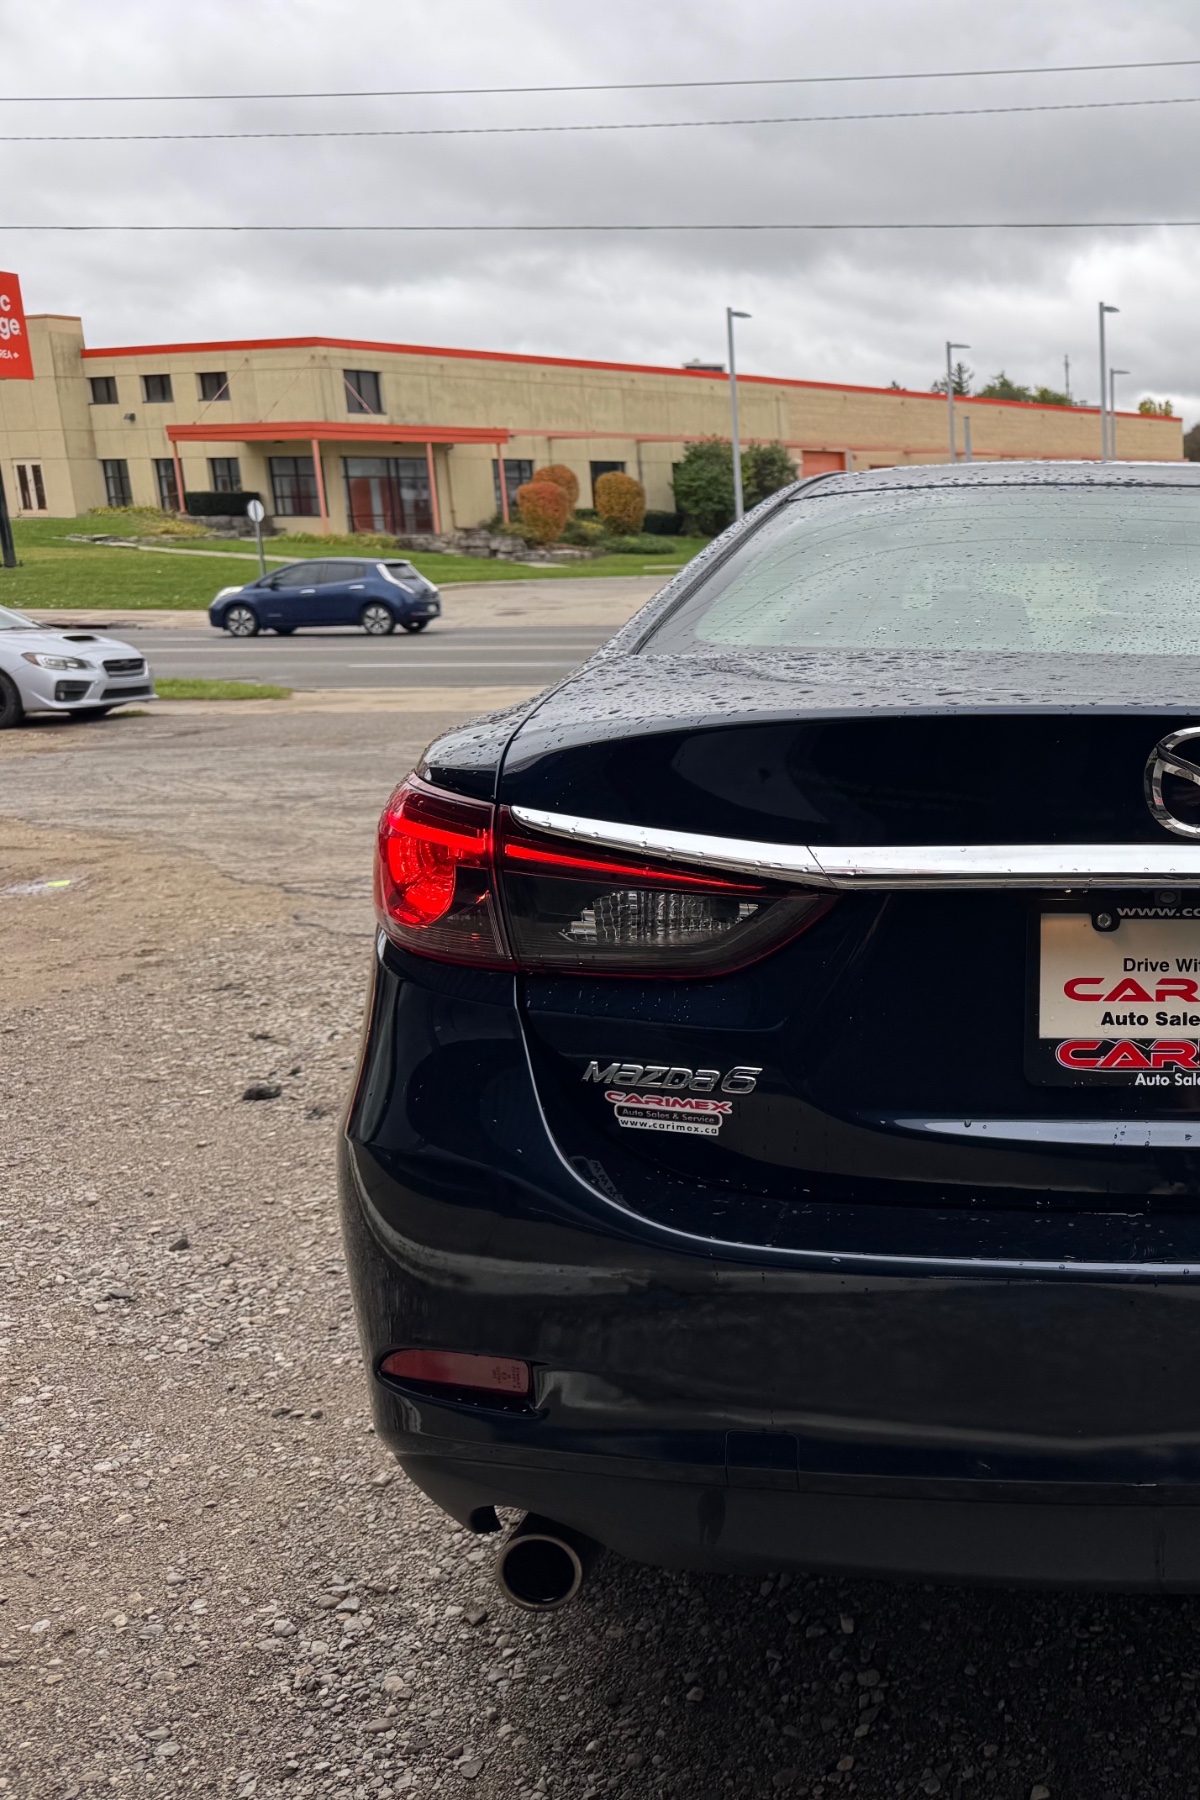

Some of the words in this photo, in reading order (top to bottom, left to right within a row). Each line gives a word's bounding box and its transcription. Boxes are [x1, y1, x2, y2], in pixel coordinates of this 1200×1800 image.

[1123, 958, 1170, 973] Drive
[1100, 1012, 1149, 1027] Auto
[1134, 1072, 1170, 1087] Auto
[605, 1091, 731, 1113] CARIMEX
[622, 1107, 644, 1118] Auto
[646, 1109, 670, 1120] Sales
[672, 1112, 680, 1120] &
[682, 1113, 715, 1124] Service
[620, 1118, 718, 1135] www.carimex.ca
